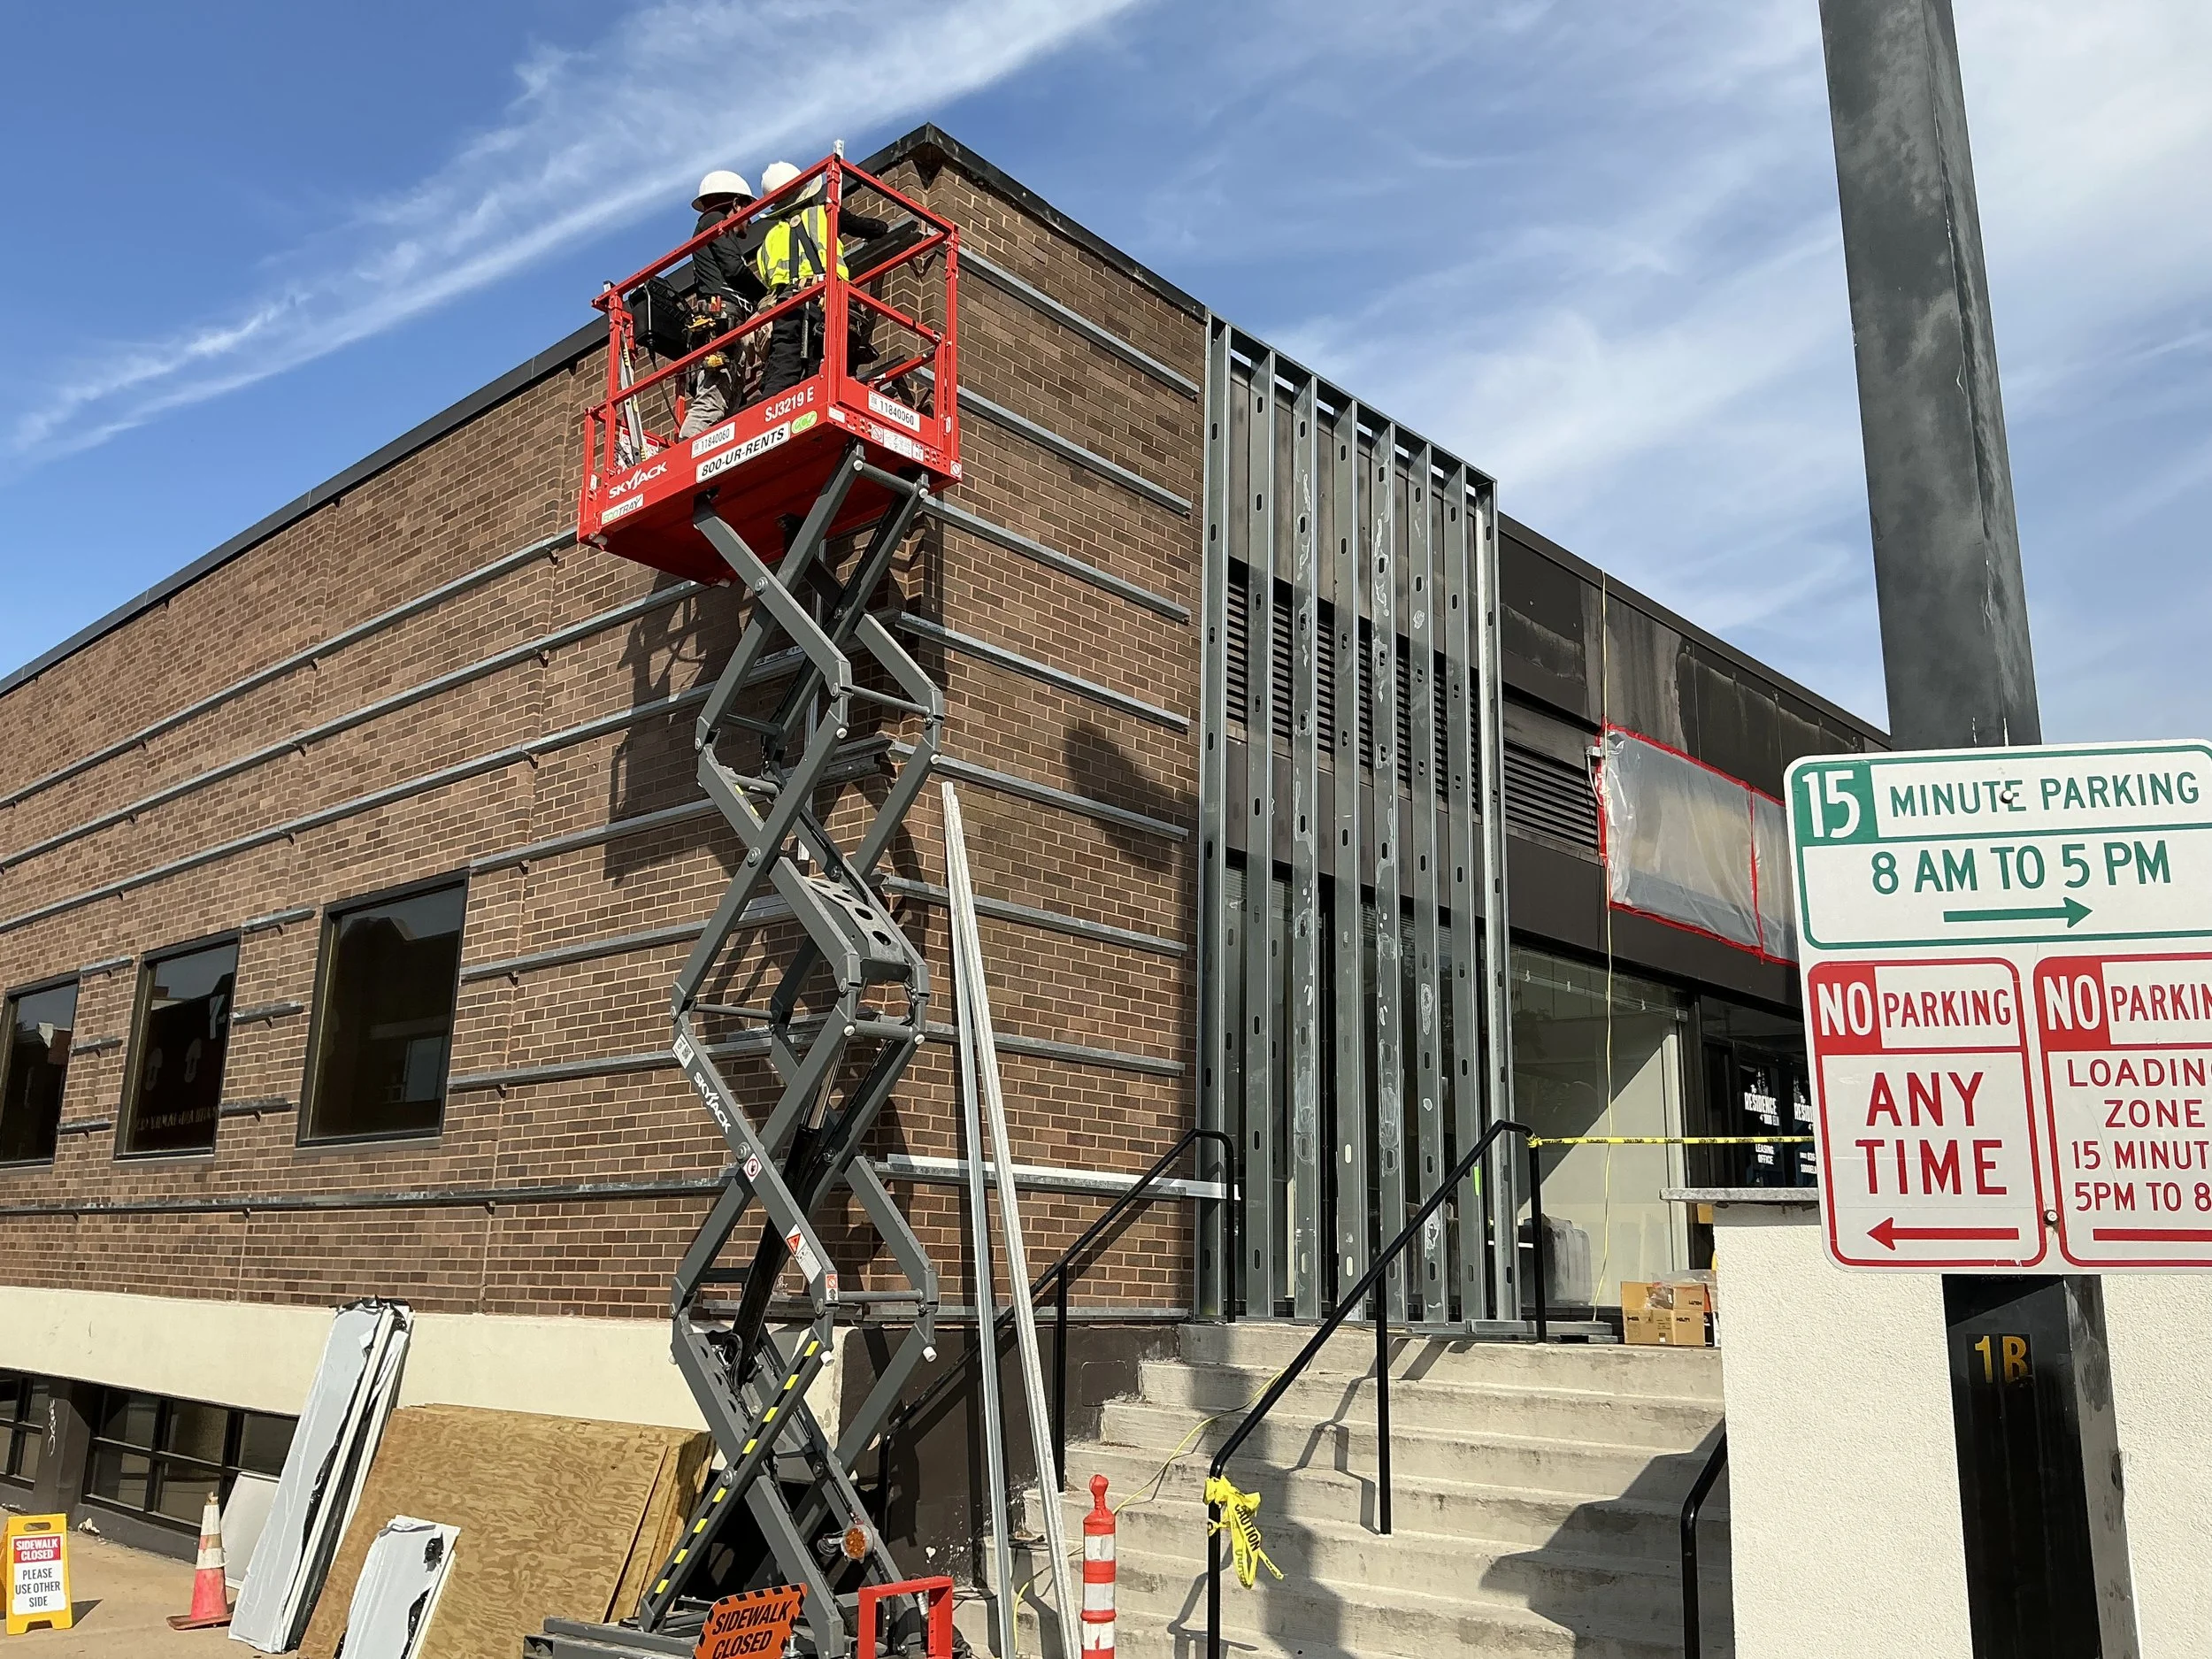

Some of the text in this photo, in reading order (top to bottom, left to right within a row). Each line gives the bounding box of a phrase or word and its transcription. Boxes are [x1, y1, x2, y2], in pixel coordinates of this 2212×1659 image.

[764, 392, 804, 422] SJ3219
[807, 386, 814, 403] E
[879, 400, 915, 426] 11840060
[701, 428, 730, 449] 11840060
[702, 427, 785, 477] 800-UR-RENTS
[609, 461, 667, 499] SKYJACK
[1802, 770, 2199, 839] 15 MINUTE PARKING
[1871, 840, 2171, 895] 8 AM TO 5 PM
[1817, 981, 2010, 1036] NO PARKING
[2042, 974, 2101, 1031] NO
[2066, 1058, 2212, 1087] LOADIN
[694, 1071, 732, 1134] SKYJACK
[1745, 1092, 1777, 1115] RESIDENCE
[1866, 1071, 1985, 1127] ANY
[2104, 1099, 2206, 1128] ZONE
[1855, 1140, 2007, 1196] TIME
[2071, 1141, 2101, 1169] 15
[2075, 1182, 2212, 1211] 5PM TO 8
[1234, 1503, 1262, 1552] CAUTION
[16, 1538, 59, 1550] SIDEWALK
[20, 1548, 54, 1562] CLOSED
[15, 1580, 61, 1594] USE OTHER
[22, 1568, 53, 1580] PLEASE
[29, 1595, 48, 1608] SIDE
[712, 1601, 793, 1635] SIDEWALK
[711, 1629, 773, 1659] CLOSED
